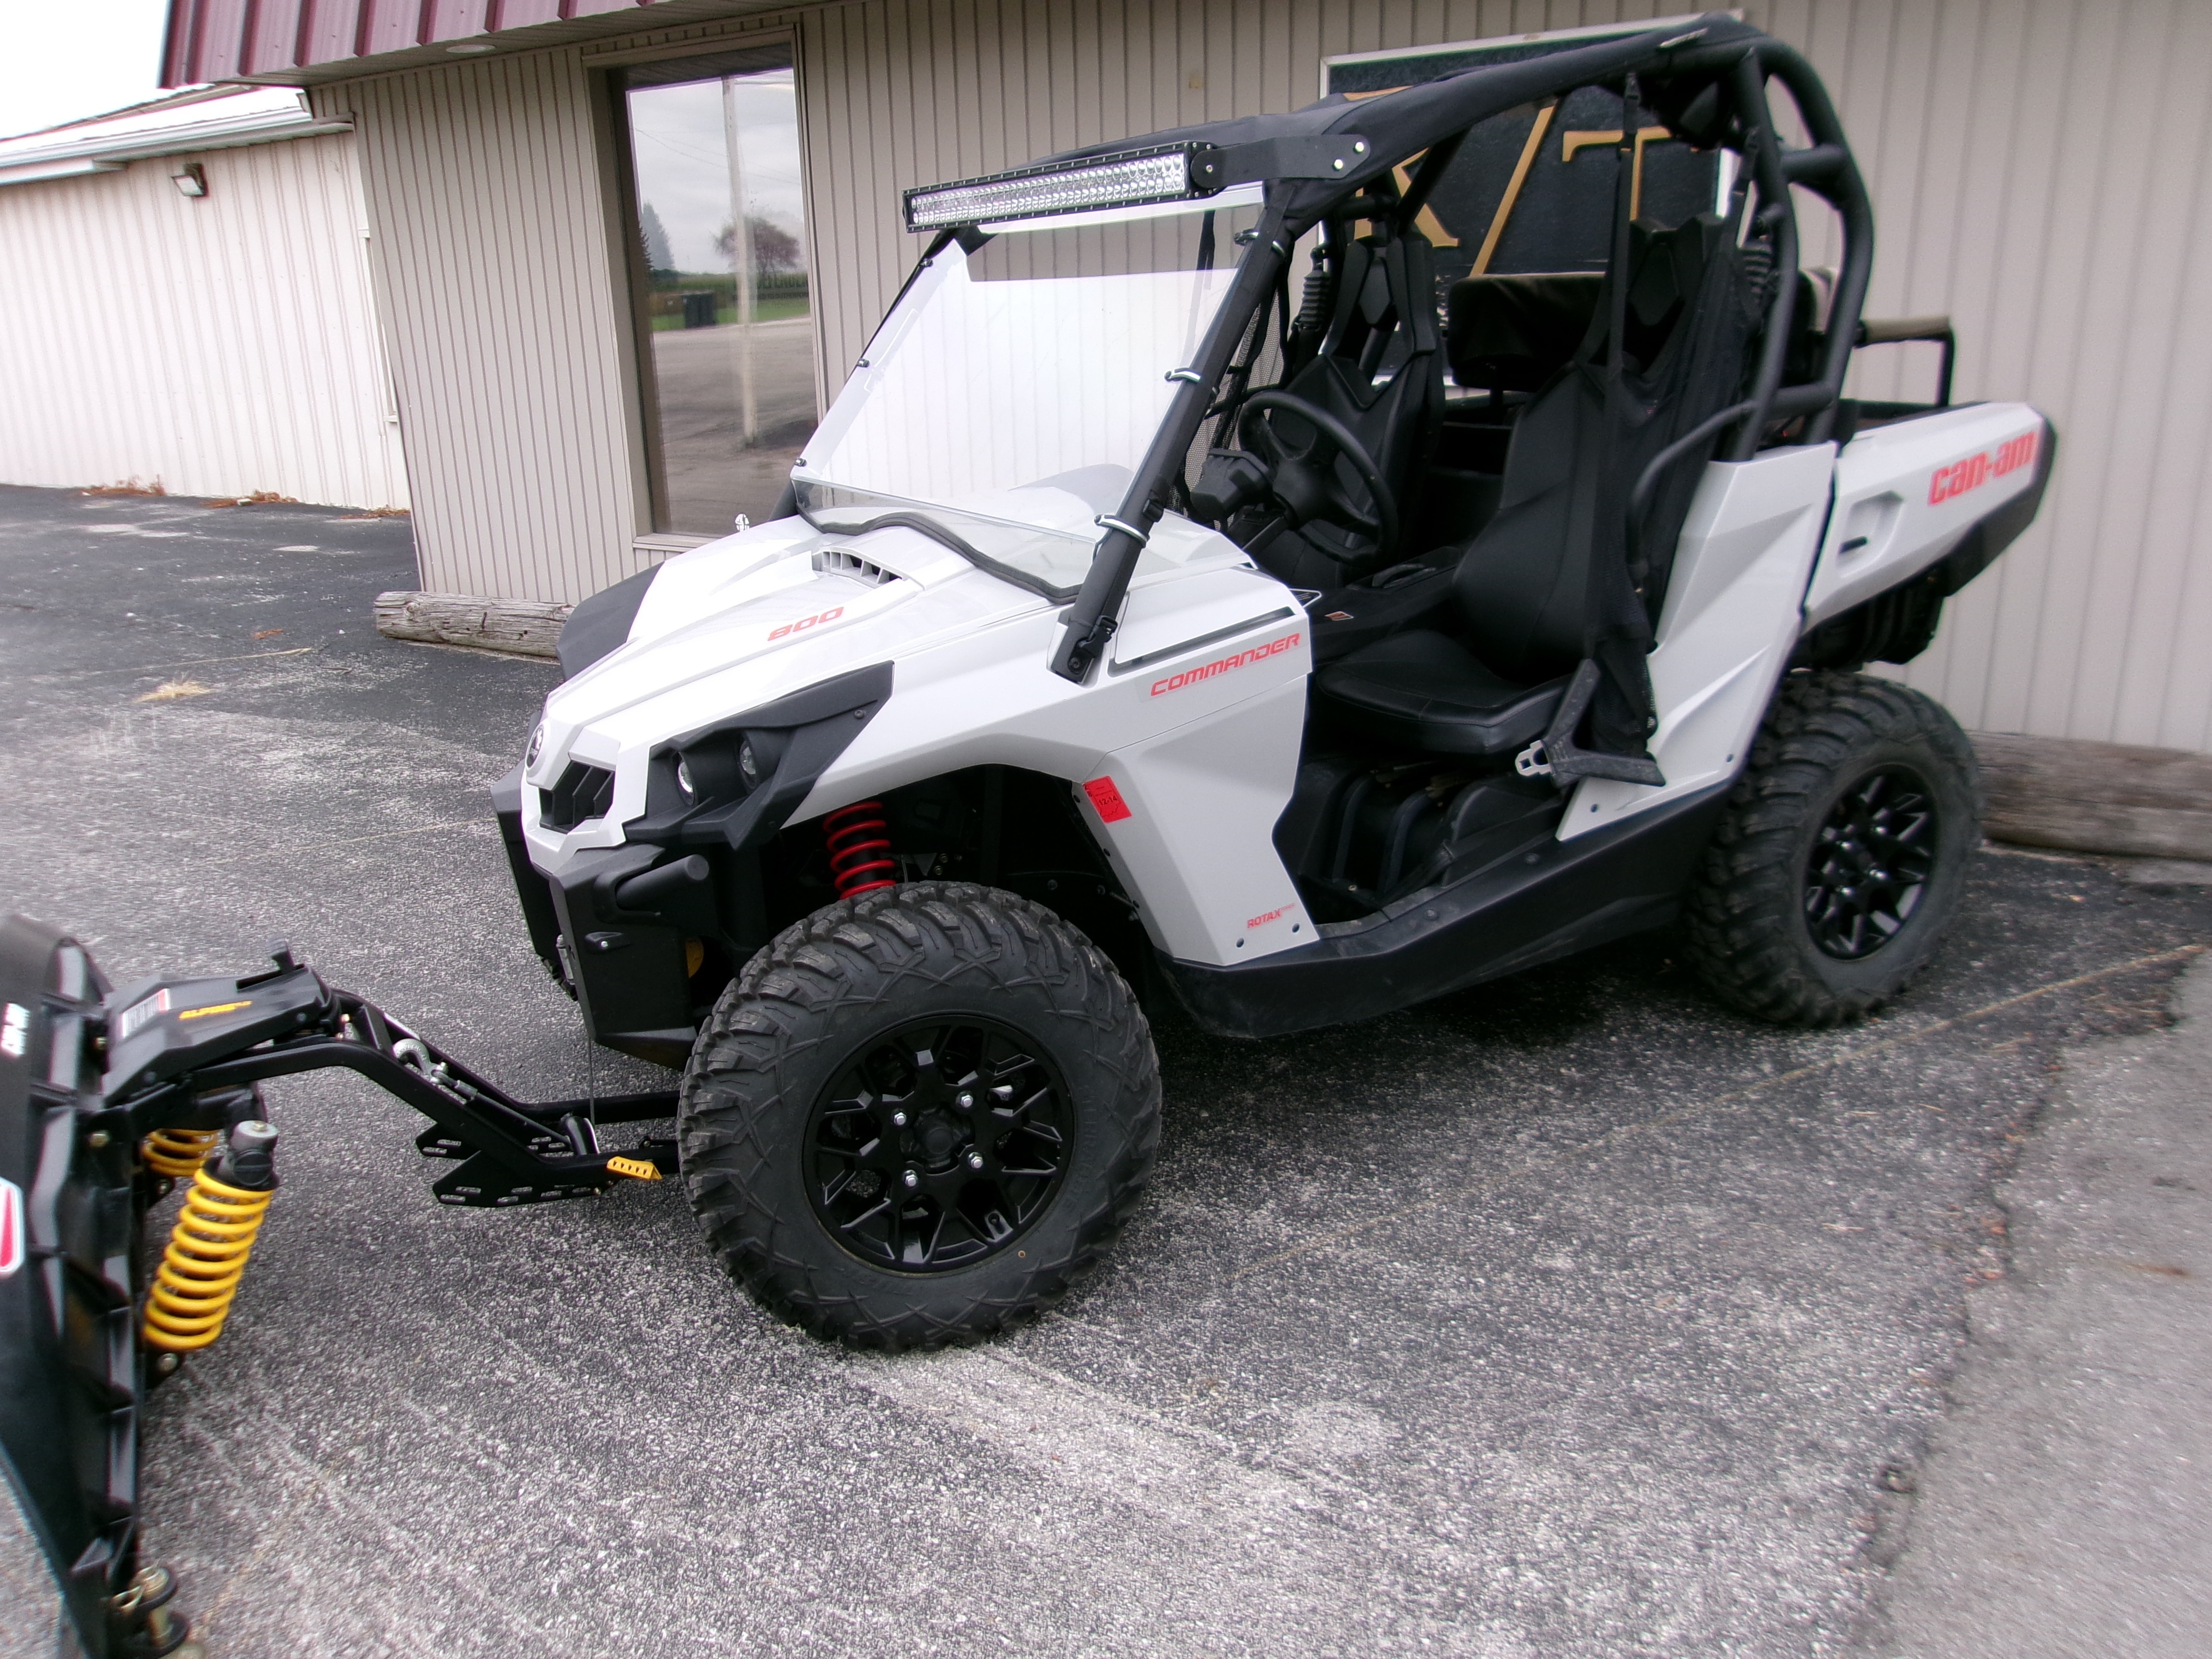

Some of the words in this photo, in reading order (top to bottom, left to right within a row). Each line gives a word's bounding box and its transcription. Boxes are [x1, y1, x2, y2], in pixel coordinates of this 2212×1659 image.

[1929, 431, 2036, 505] can-am
[767, 606, 844, 641] 800
[1150, 632, 1301, 697] COMMANDER
[1098, 795, 1118, 805] 12-14
[1247, 908, 1282, 928] ROTAX
